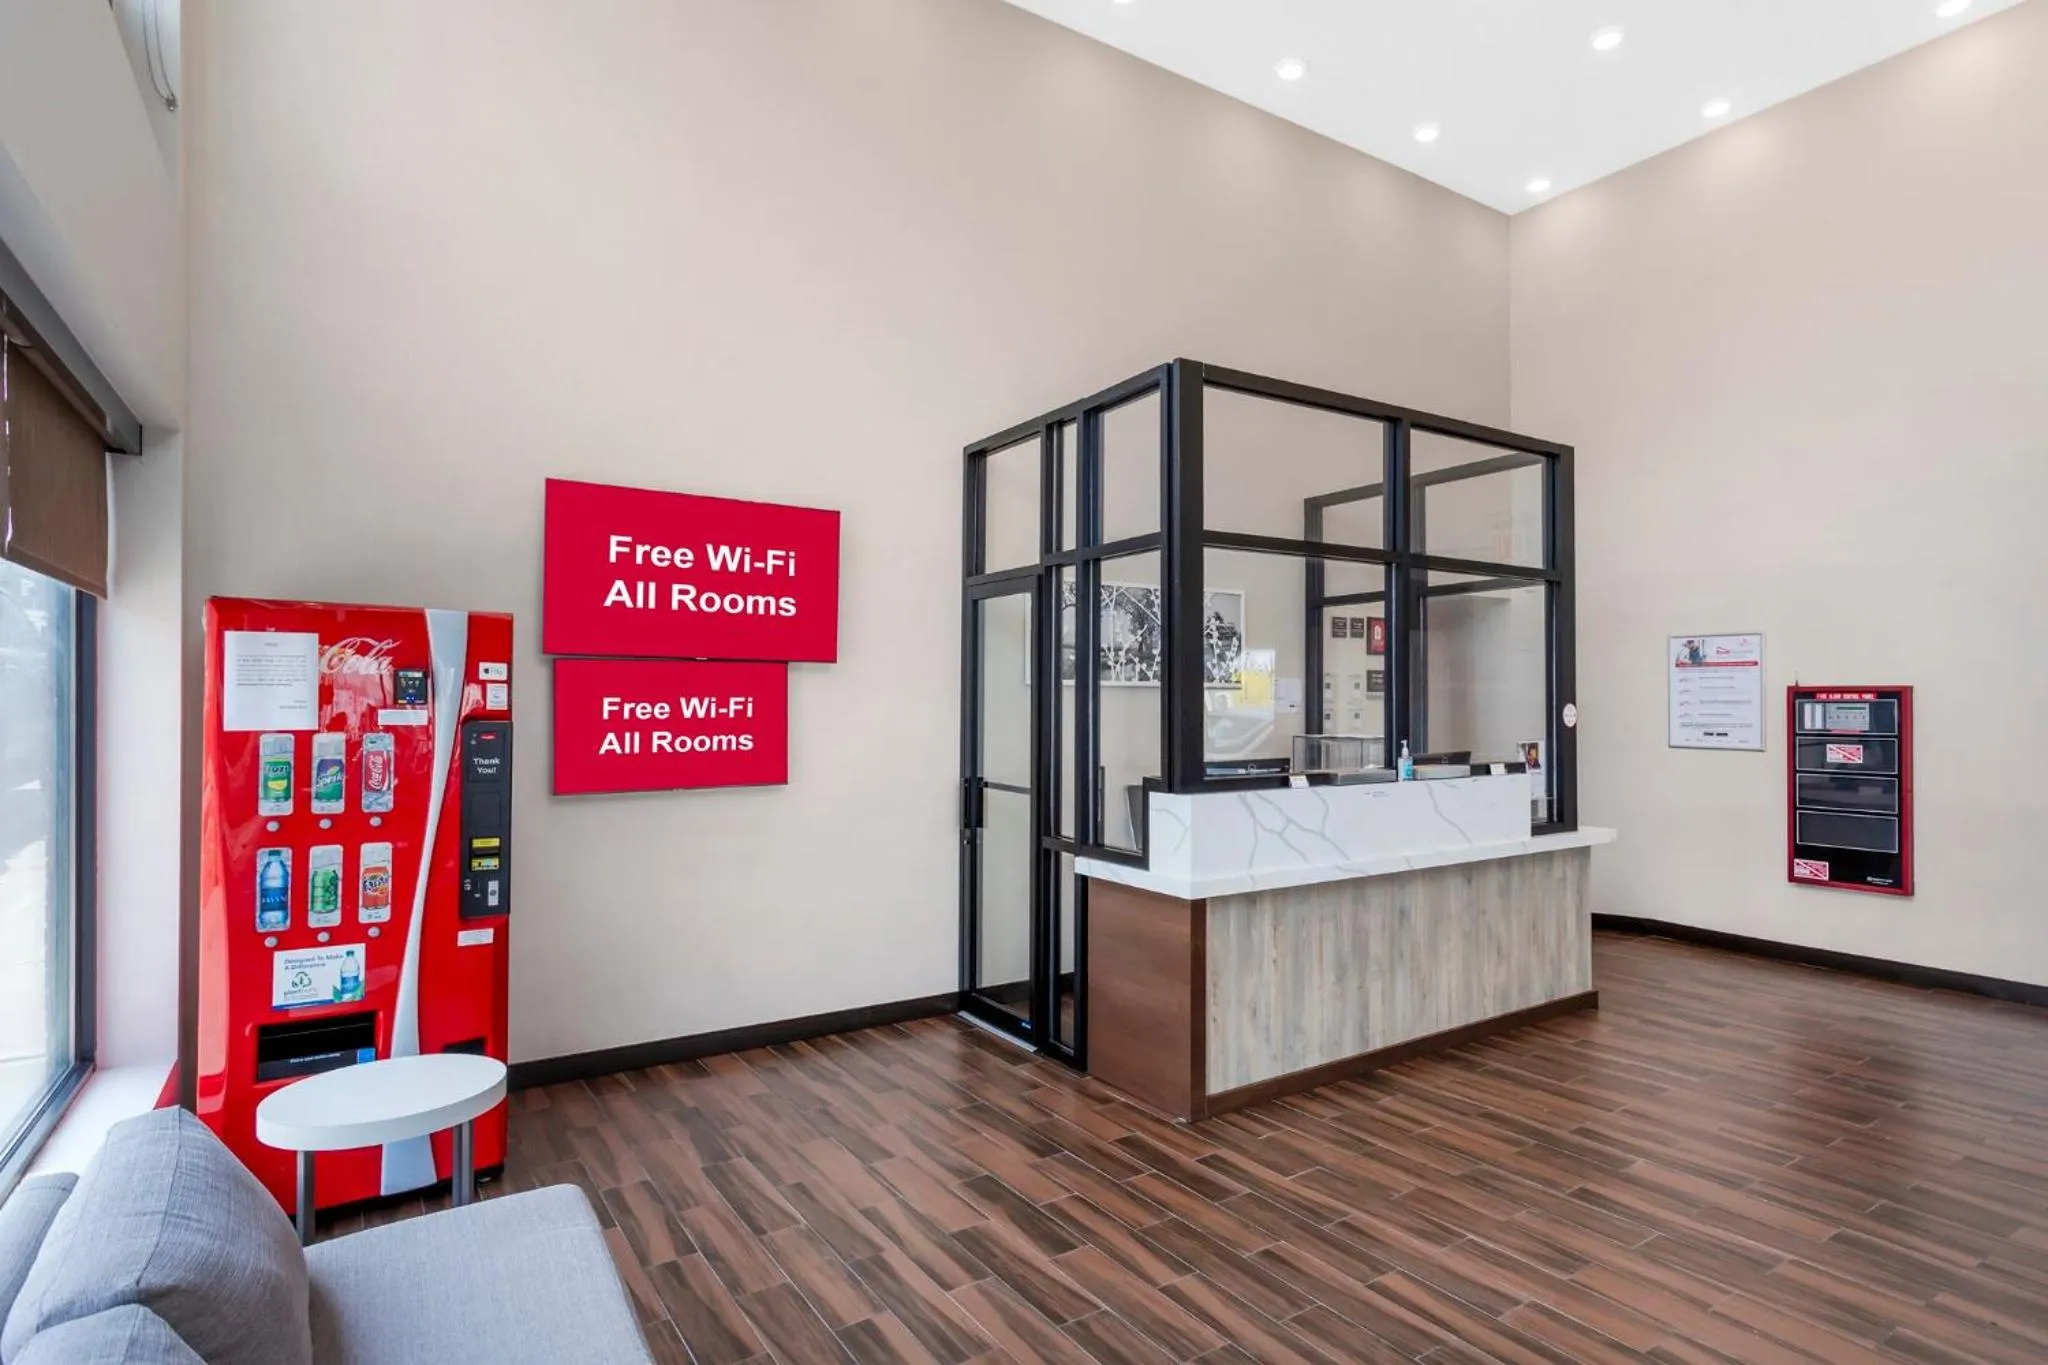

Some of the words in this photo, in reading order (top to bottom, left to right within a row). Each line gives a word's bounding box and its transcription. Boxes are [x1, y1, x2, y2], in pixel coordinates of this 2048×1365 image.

[609, 534, 695, 569] Free
[706, 543, 796, 577] Wi-Fi
[603, 579, 656, 609] All
[671, 583, 797, 617] Rooms
[602, 697, 671, 720] Free
[680, 697, 754, 719] Wi-Fi
[599, 731, 640, 755] All
[652, 731, 754, 753] Rooms
[473, 757, 501, 765] Thank
[477, 766, 497, 774] You!
